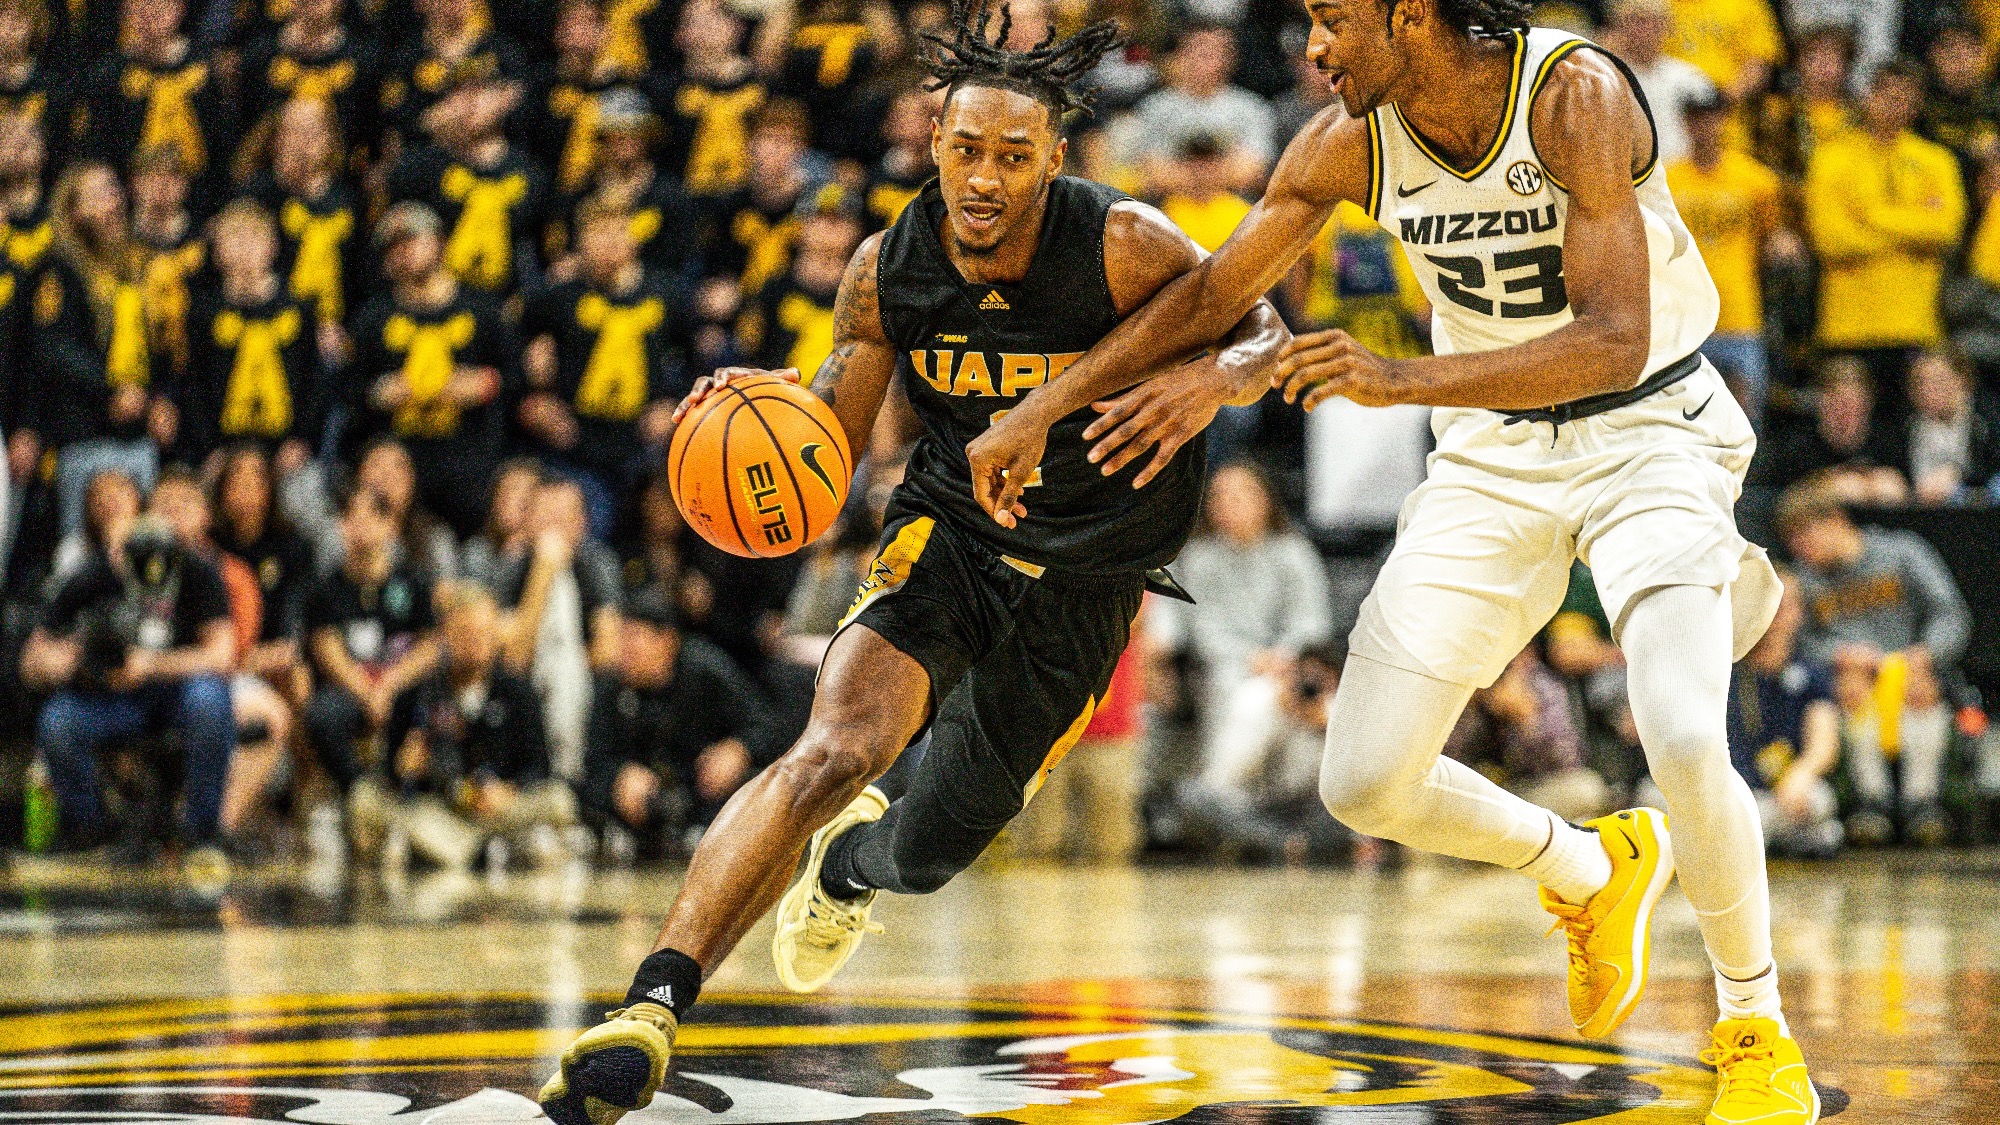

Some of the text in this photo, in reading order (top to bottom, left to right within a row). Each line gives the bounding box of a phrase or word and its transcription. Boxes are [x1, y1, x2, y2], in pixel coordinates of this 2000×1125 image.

[1507, 160, 1542, 196] SEC
[1400, 203, 1558, 245] MIZZOU
[1423, 245, 1569, 319] 23
[979, 302, 1010, 310] adidas
[746, 461, 793, 546] ELITE
